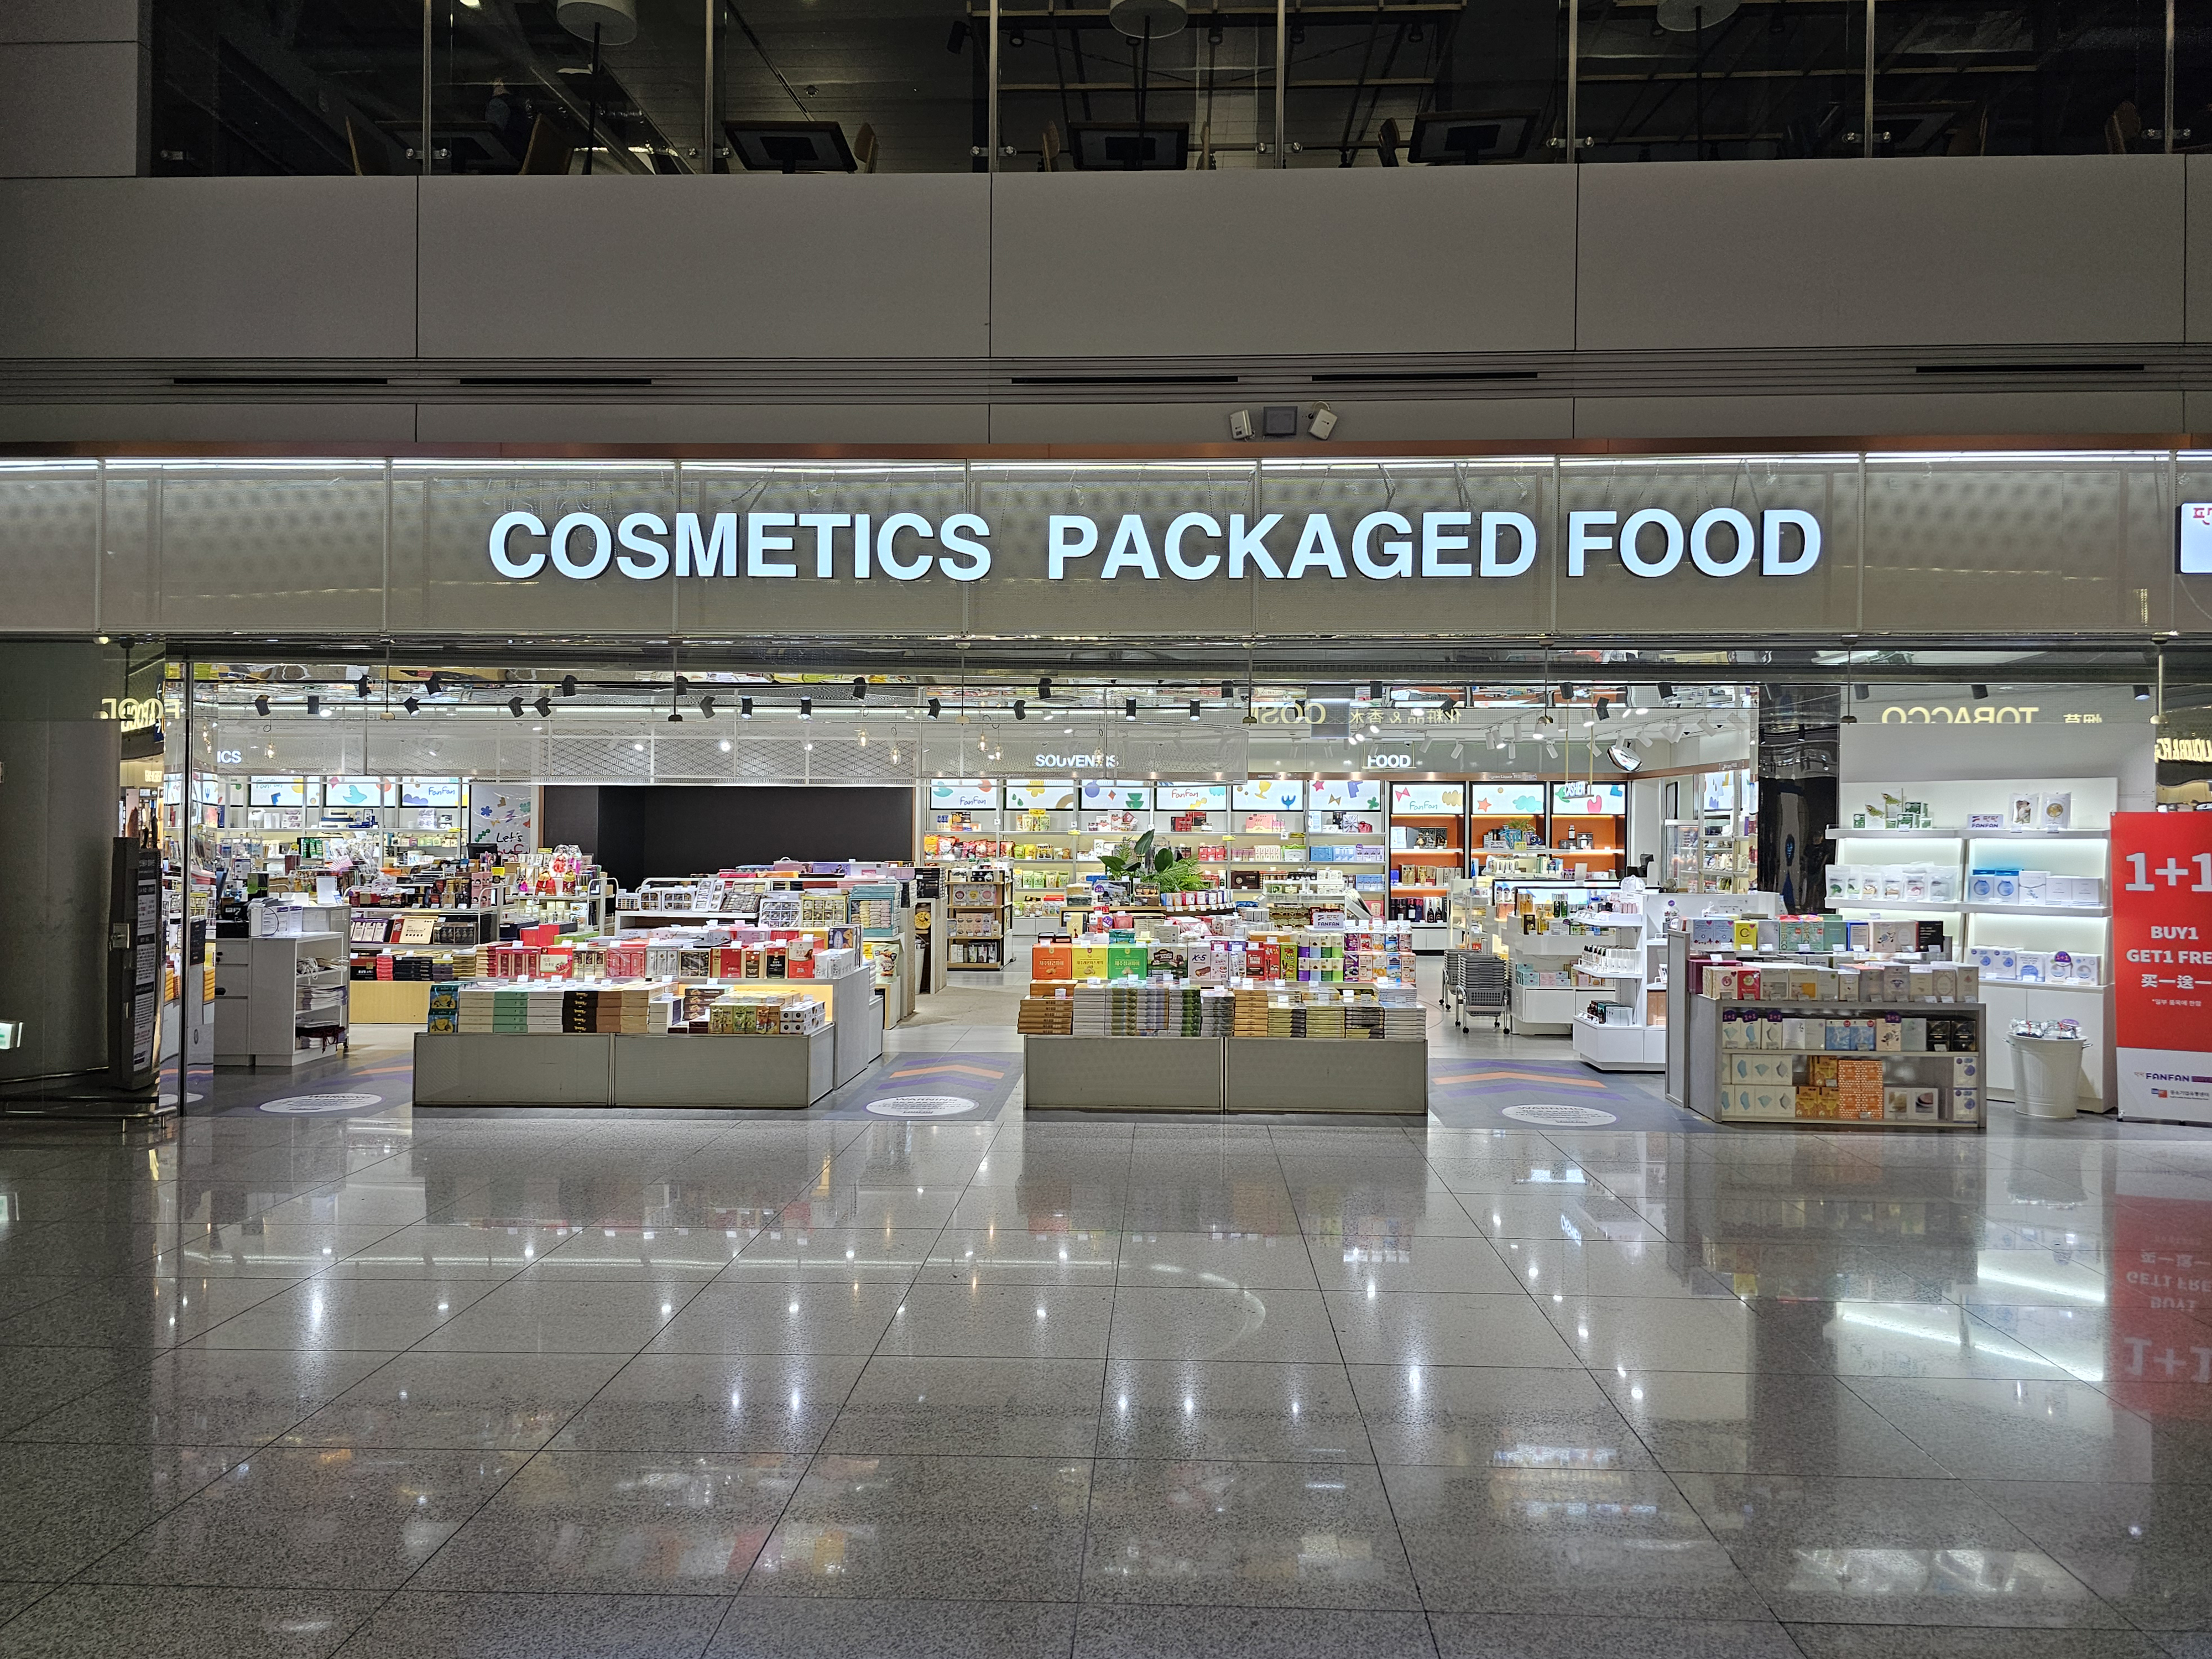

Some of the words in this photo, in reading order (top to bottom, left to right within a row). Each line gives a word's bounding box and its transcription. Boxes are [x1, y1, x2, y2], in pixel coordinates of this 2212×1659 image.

[488, 511, 992, 581] COSMETICS
[1048, 510, 1537, 580] PACKAGED
[1566, 508, 1822, 578] FOOD
[1367, 754, 1411, 768] FOOD
[428, 786, 455, 796] FanFan
[1171, 788, 1198, 799] FanFan
[959, 796, 986, 805] FanFan
[1410, 800, 1438, 811] FanFan
[496, 832, 523, 843] Let's
[2151, 926, 2199, 940] BUY1
[2126, 948, 2174, 963] GET1
[2141, 974, 2212, 989] 买一送一
[2146, 1073, 2190, 1082] FANFAN
